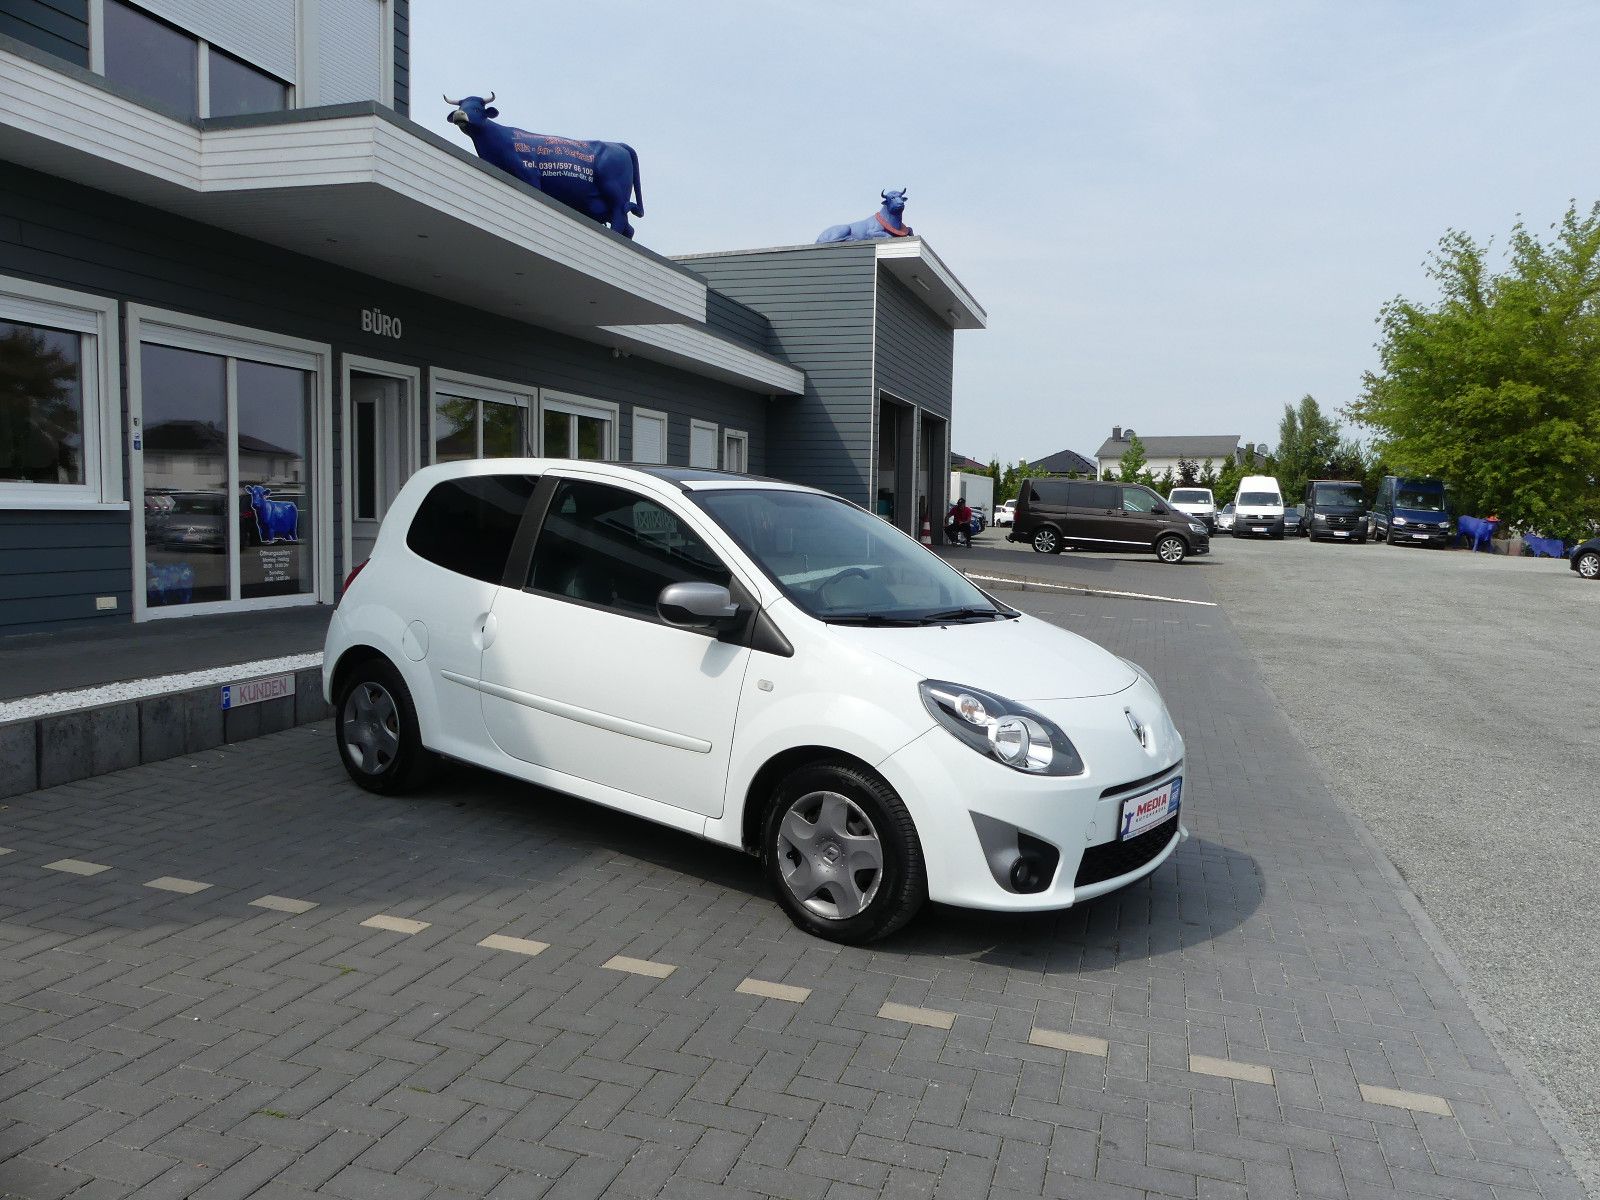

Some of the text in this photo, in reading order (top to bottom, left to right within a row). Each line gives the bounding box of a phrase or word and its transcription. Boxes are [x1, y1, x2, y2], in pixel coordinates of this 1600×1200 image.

[523, 160, 537, 169] Tel.
[539, 162, 572, 171] 0391/597
[583, 167, 594, 176] 100
[362, 308, 402, 339] BÜRO
[223, 677, 287, 704] P KUNDEN
[1137, 794, 1167, 817] MEDIA
